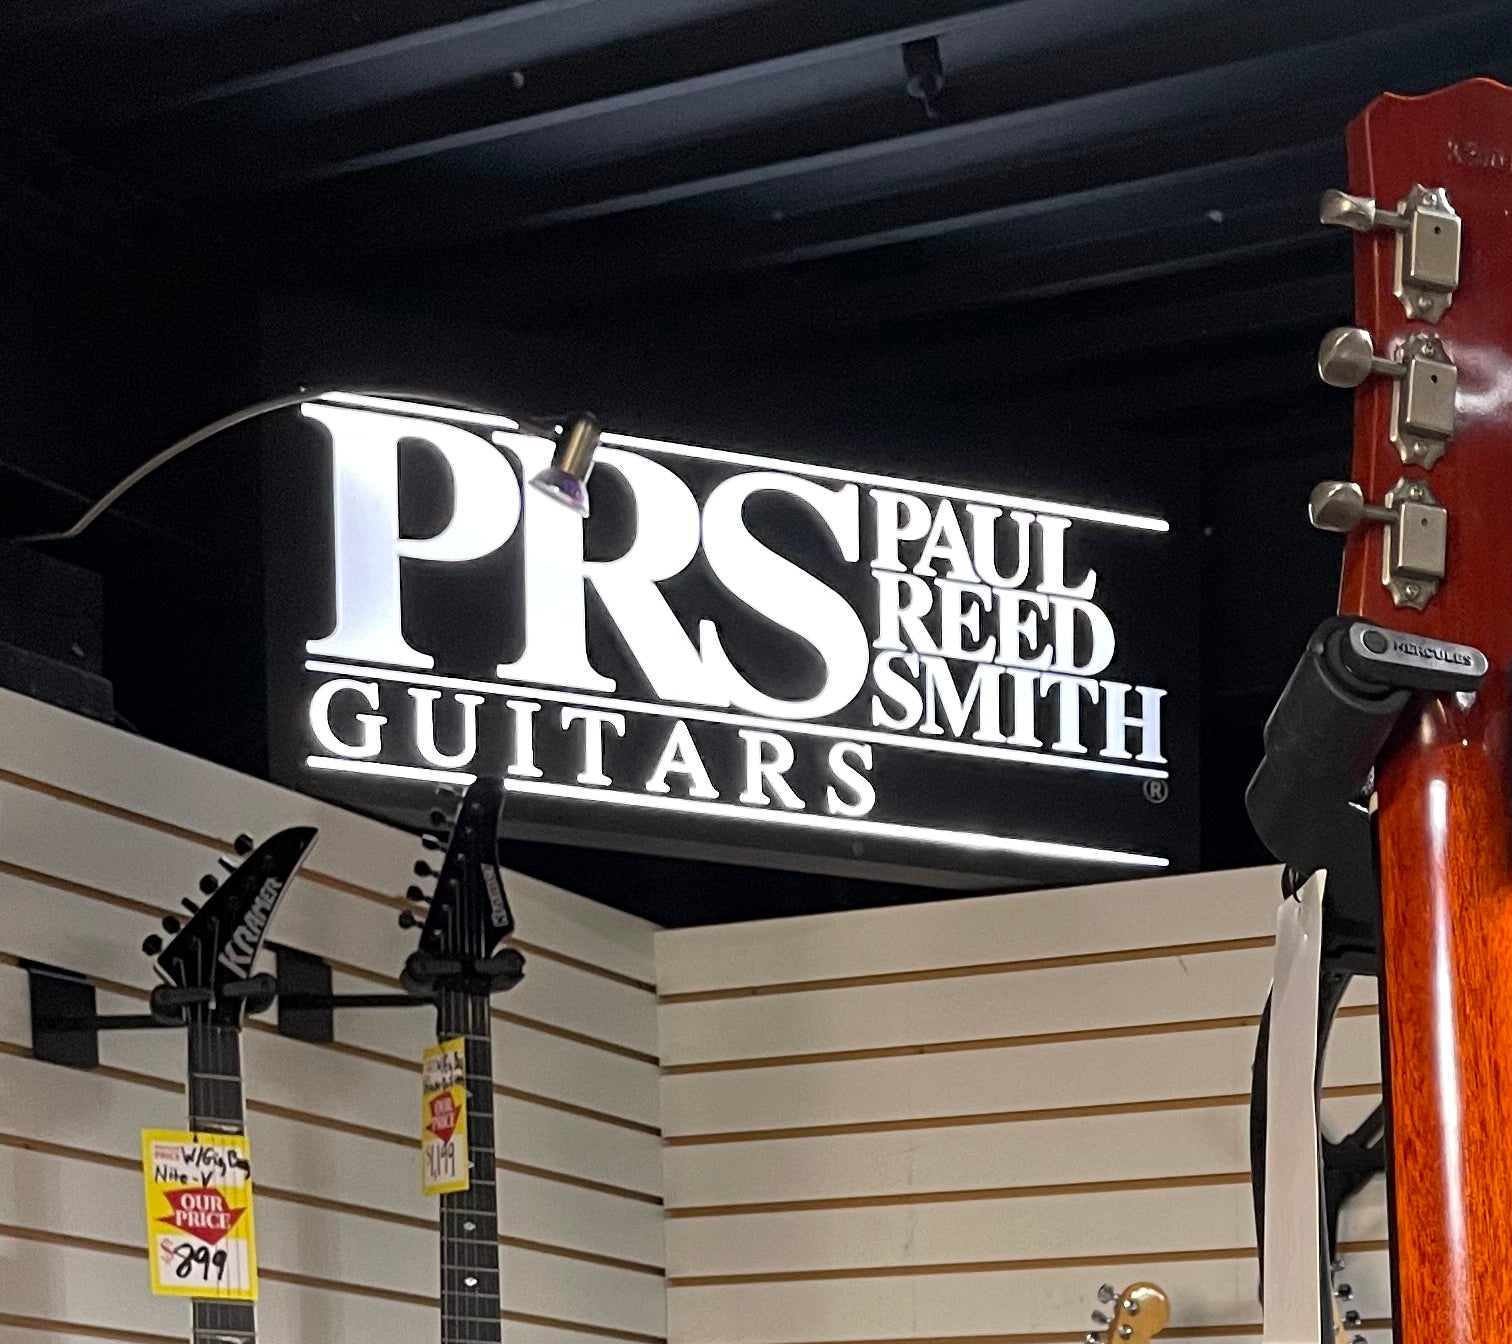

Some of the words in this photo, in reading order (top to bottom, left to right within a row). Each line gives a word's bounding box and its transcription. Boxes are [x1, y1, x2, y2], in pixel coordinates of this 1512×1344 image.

[301, 402, 870, 719] PRS
[870, 487, 1096, 599] PAUL
[873, 567, 1116, 677] REED
[1393, 639, 1472, 666] HERCULES
[308, 680, 877, 817] GUITARS
[871, 651, 1168, 765] SMITH
[218, 876, 283, 979] KRAMER
[175, 1209, 232, 1230] PRICE
[180, 1193, 223, 1212] OUR
